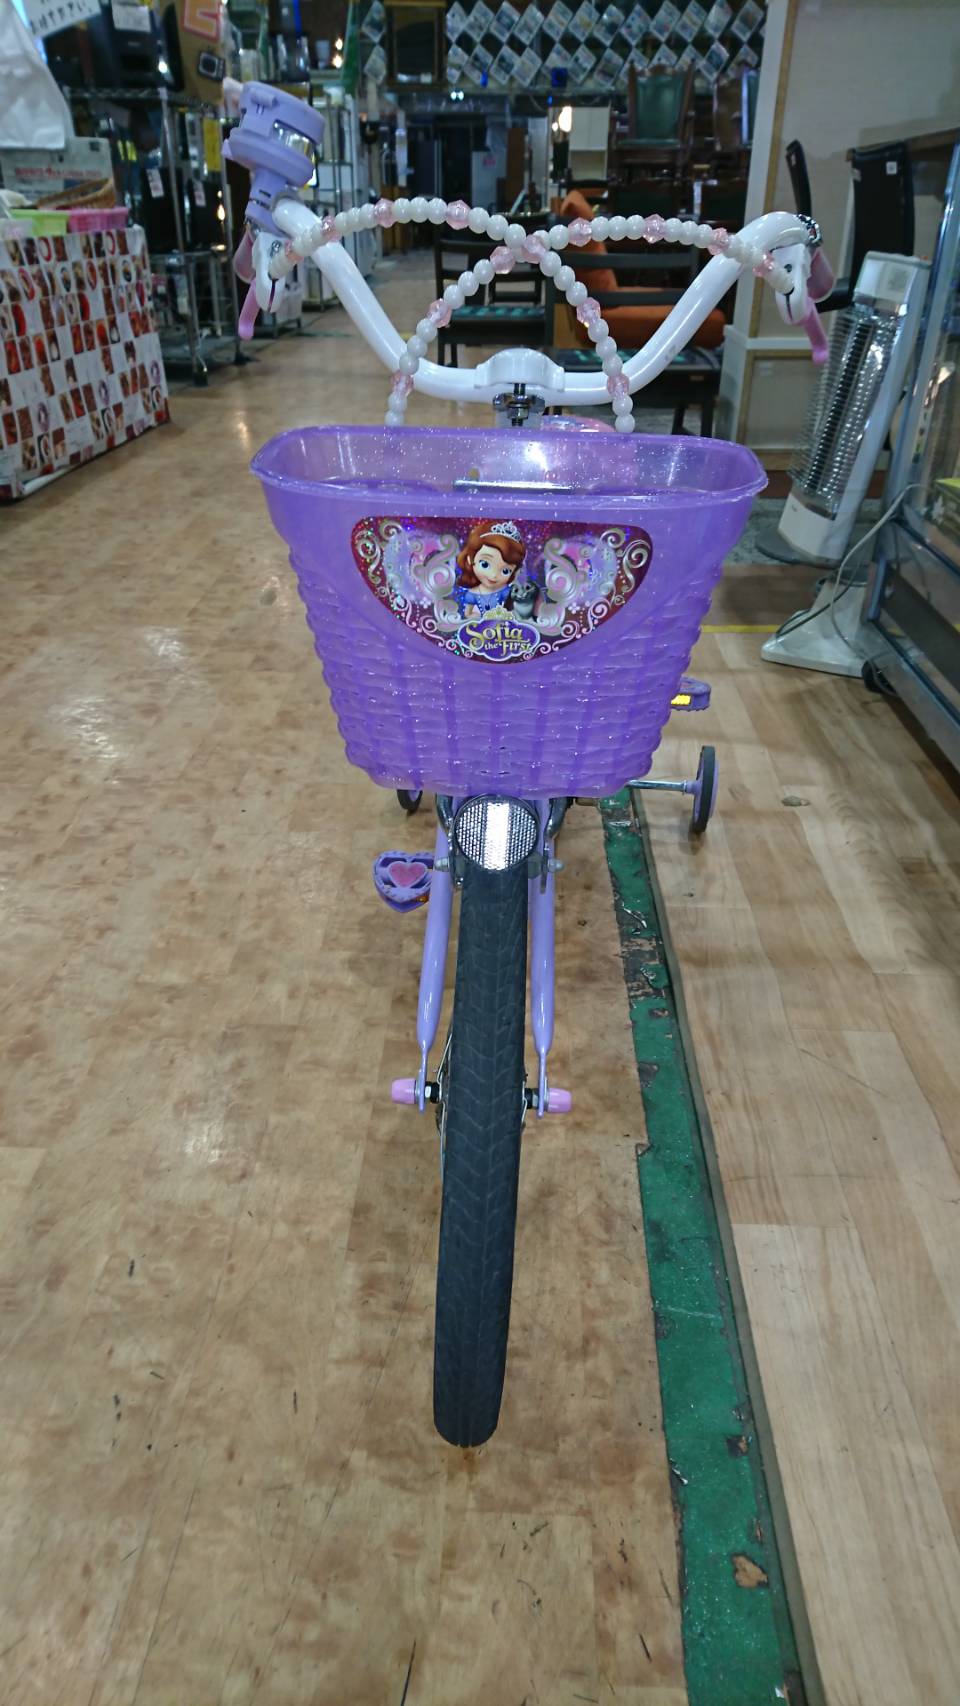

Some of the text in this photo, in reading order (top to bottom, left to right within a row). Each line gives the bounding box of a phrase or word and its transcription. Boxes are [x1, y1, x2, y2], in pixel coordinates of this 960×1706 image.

[465, 622, 523, 651] Sofia
[484, 639, 532, 657] the First
